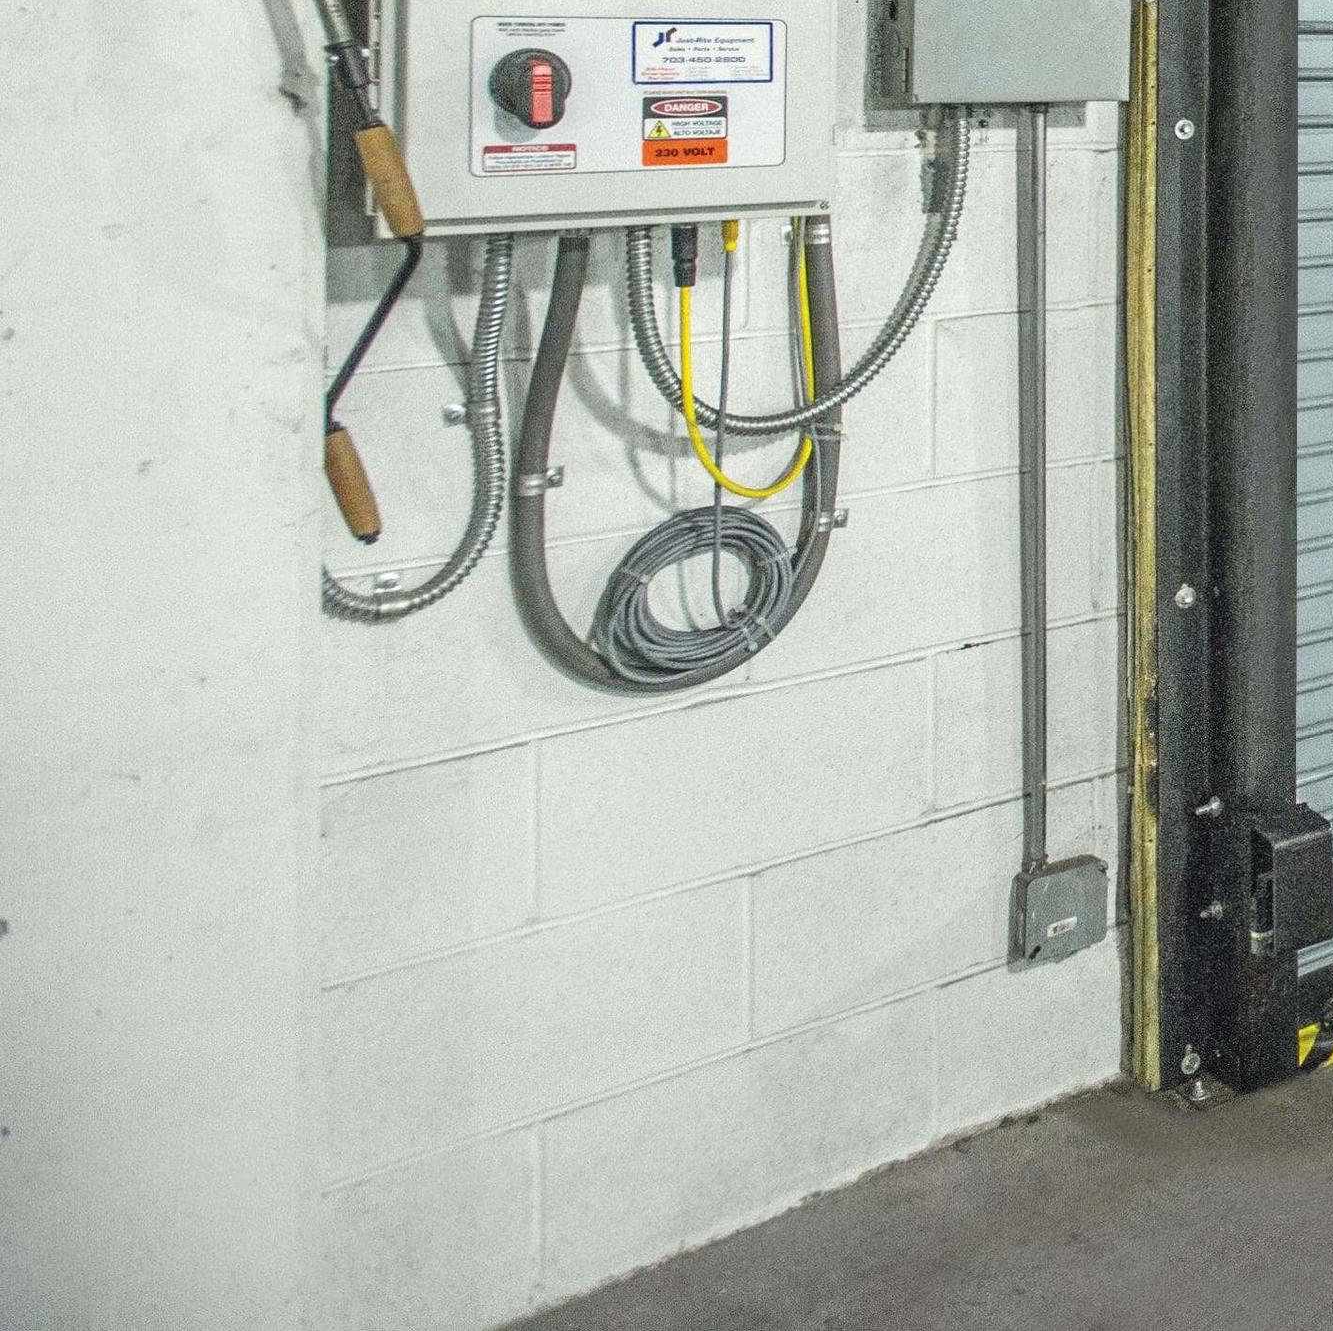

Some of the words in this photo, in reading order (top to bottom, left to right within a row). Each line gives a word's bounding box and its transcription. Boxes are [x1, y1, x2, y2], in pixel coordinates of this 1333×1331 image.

[714, 37, 754, 45] Equipment
[664, 103, 709, 112] DANGER
[655, 148, 679, 157] 230
[683, 147, 716, 156] VOLT
